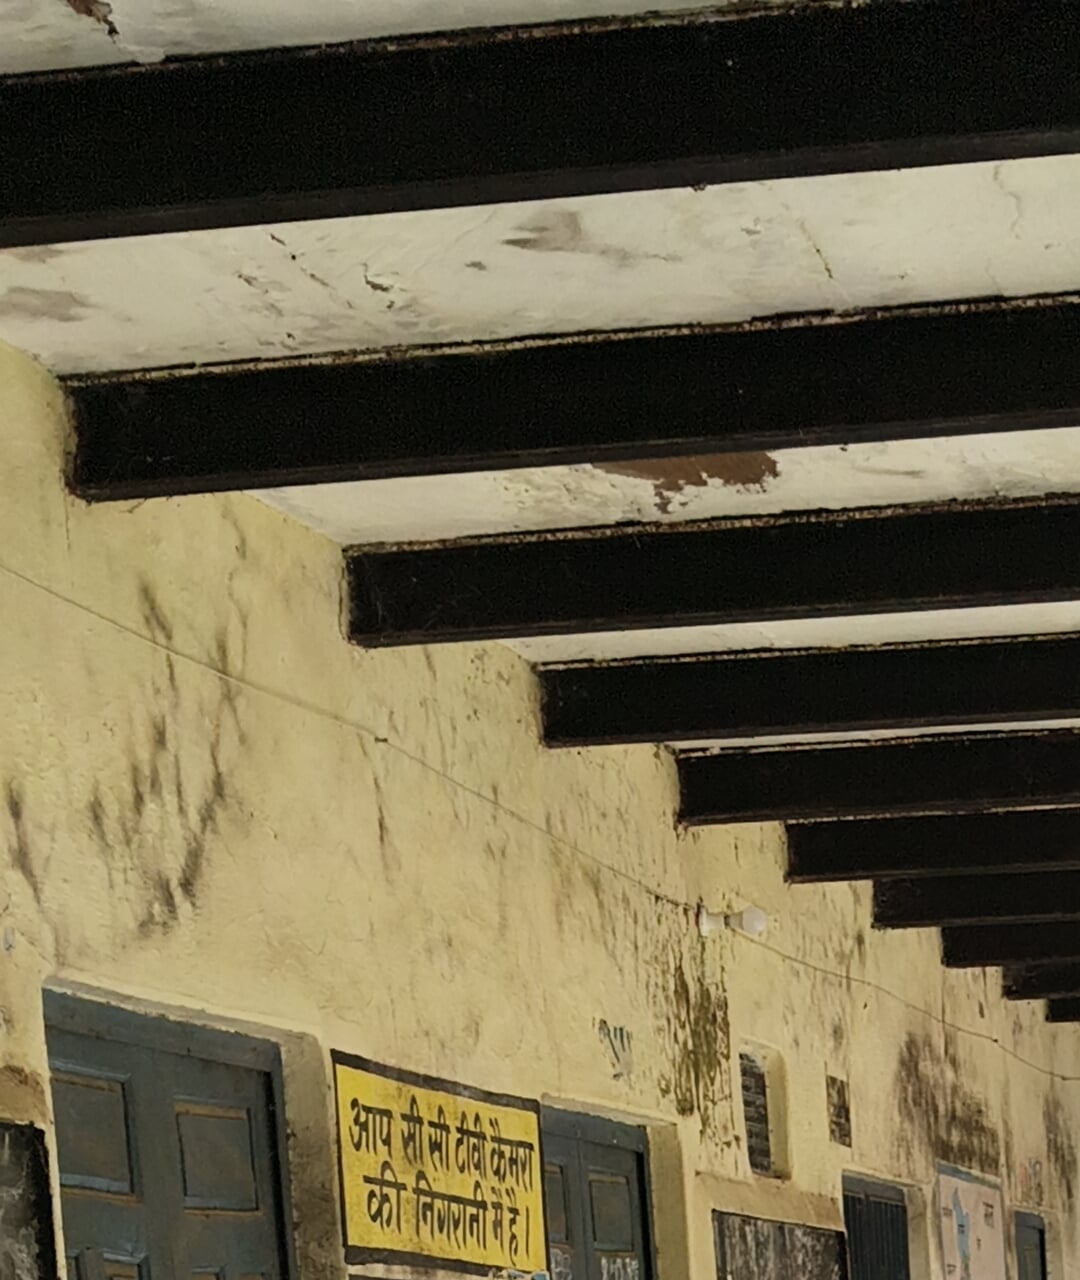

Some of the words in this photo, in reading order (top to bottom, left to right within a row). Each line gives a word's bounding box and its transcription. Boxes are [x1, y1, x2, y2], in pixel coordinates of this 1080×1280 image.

[349, 1098, 393, 1157] आप
[401, 1095, 425, 1166] सी
[428, 1105, 450, 1173] सी
[489, 1117, 534, 1192] कैमरा
[363, 1161, 407, 1234] की
[413, 1170, 488, 1250] निगरानी
